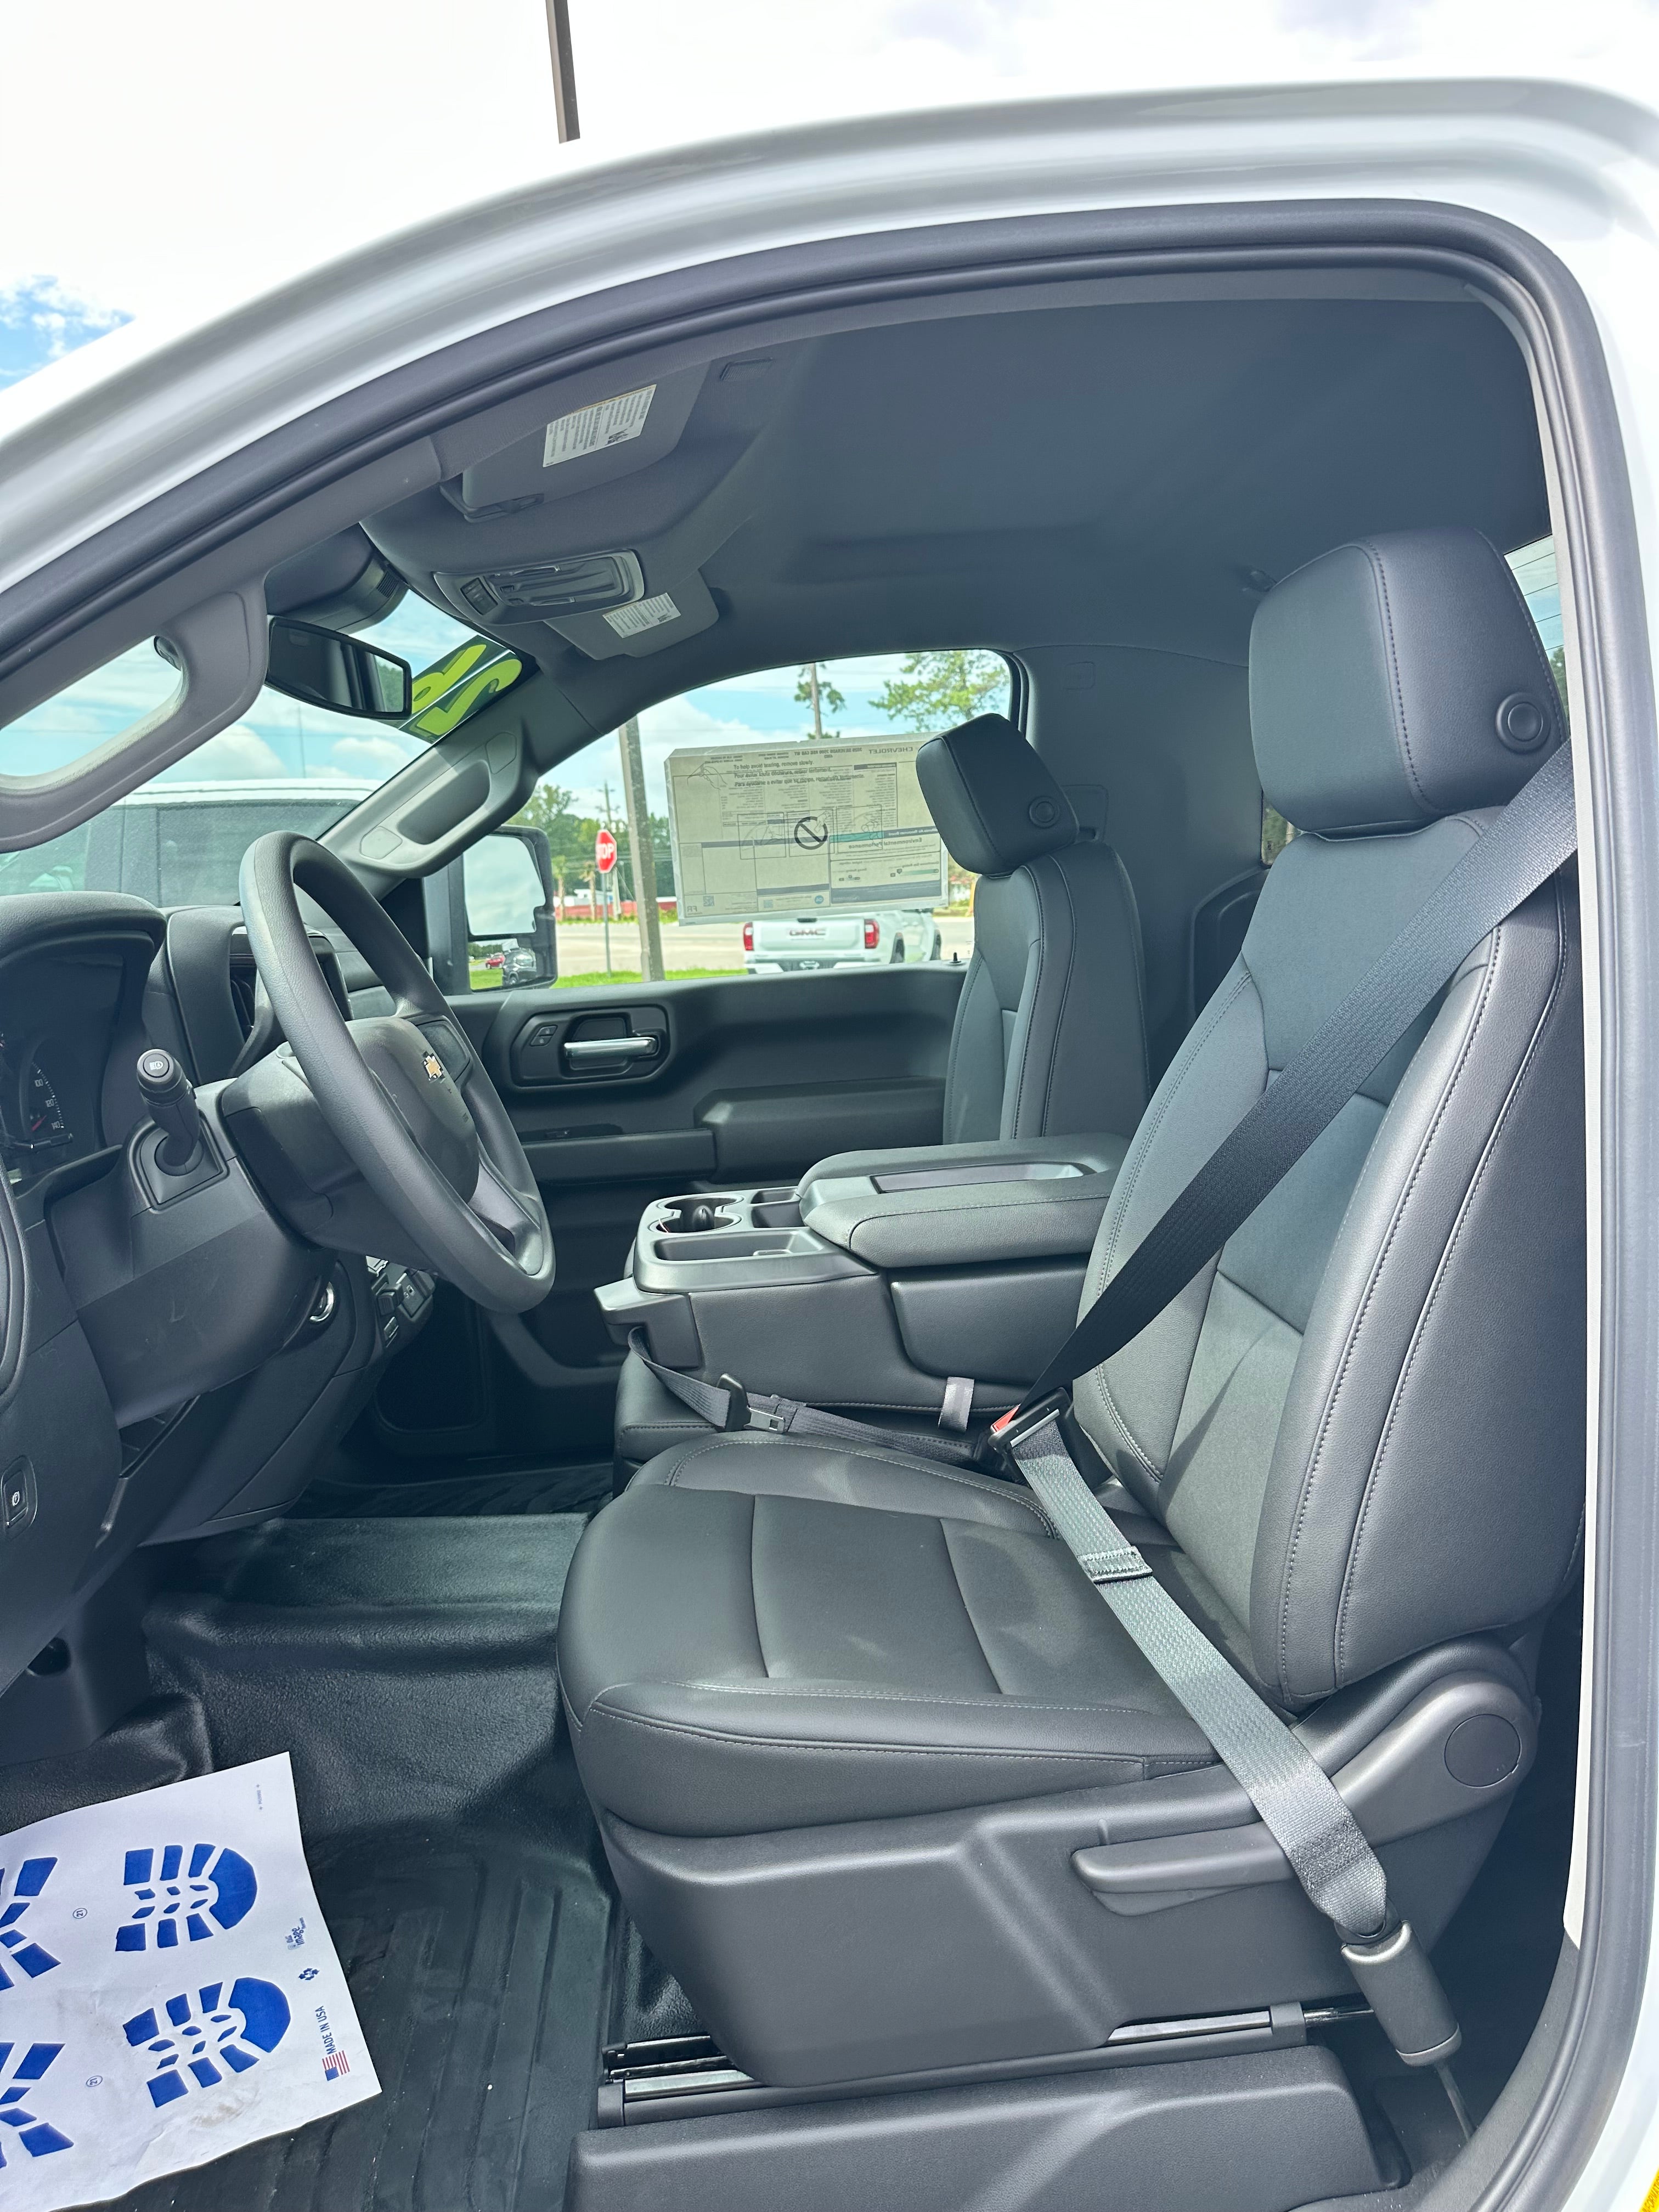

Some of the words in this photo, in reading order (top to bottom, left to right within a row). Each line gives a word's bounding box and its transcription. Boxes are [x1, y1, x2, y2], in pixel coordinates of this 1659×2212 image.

[788, 928, 827, 936] GMC
[314, 2005, 328, 2023] USA
[319, 2022, 330, 2033] IN
[322, 2032, 337, 2055] MADE
